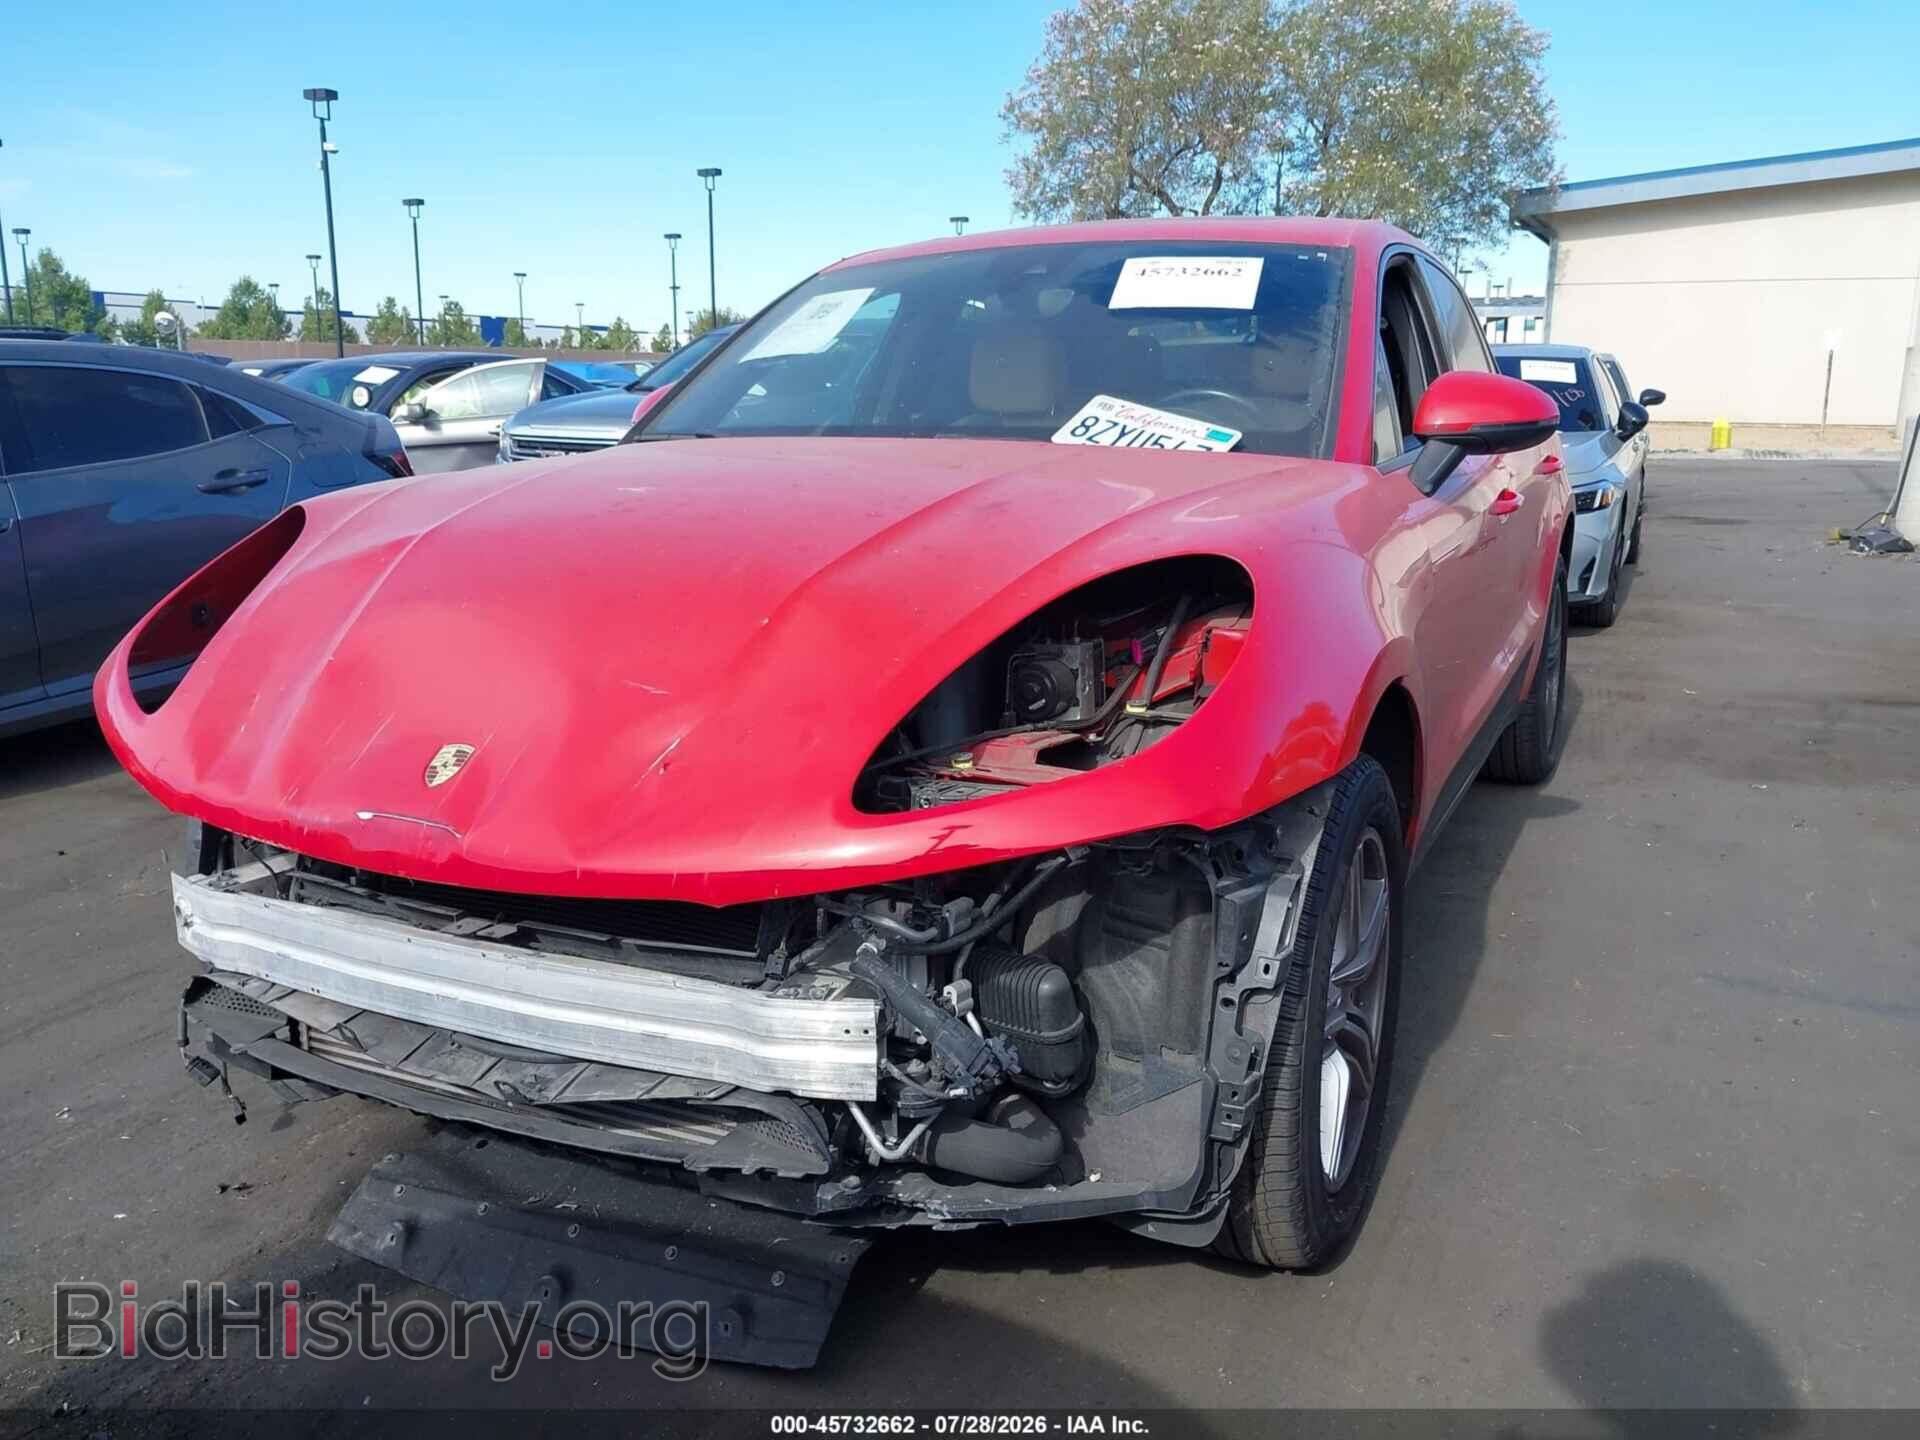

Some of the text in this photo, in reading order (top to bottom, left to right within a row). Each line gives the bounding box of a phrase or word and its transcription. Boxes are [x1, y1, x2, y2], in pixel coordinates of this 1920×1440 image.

[1136, 266, 1243, 278] 45732662
[1070, 415, 1213, 451] 8ZYU5
[1114, 406, 1207, 440] California
